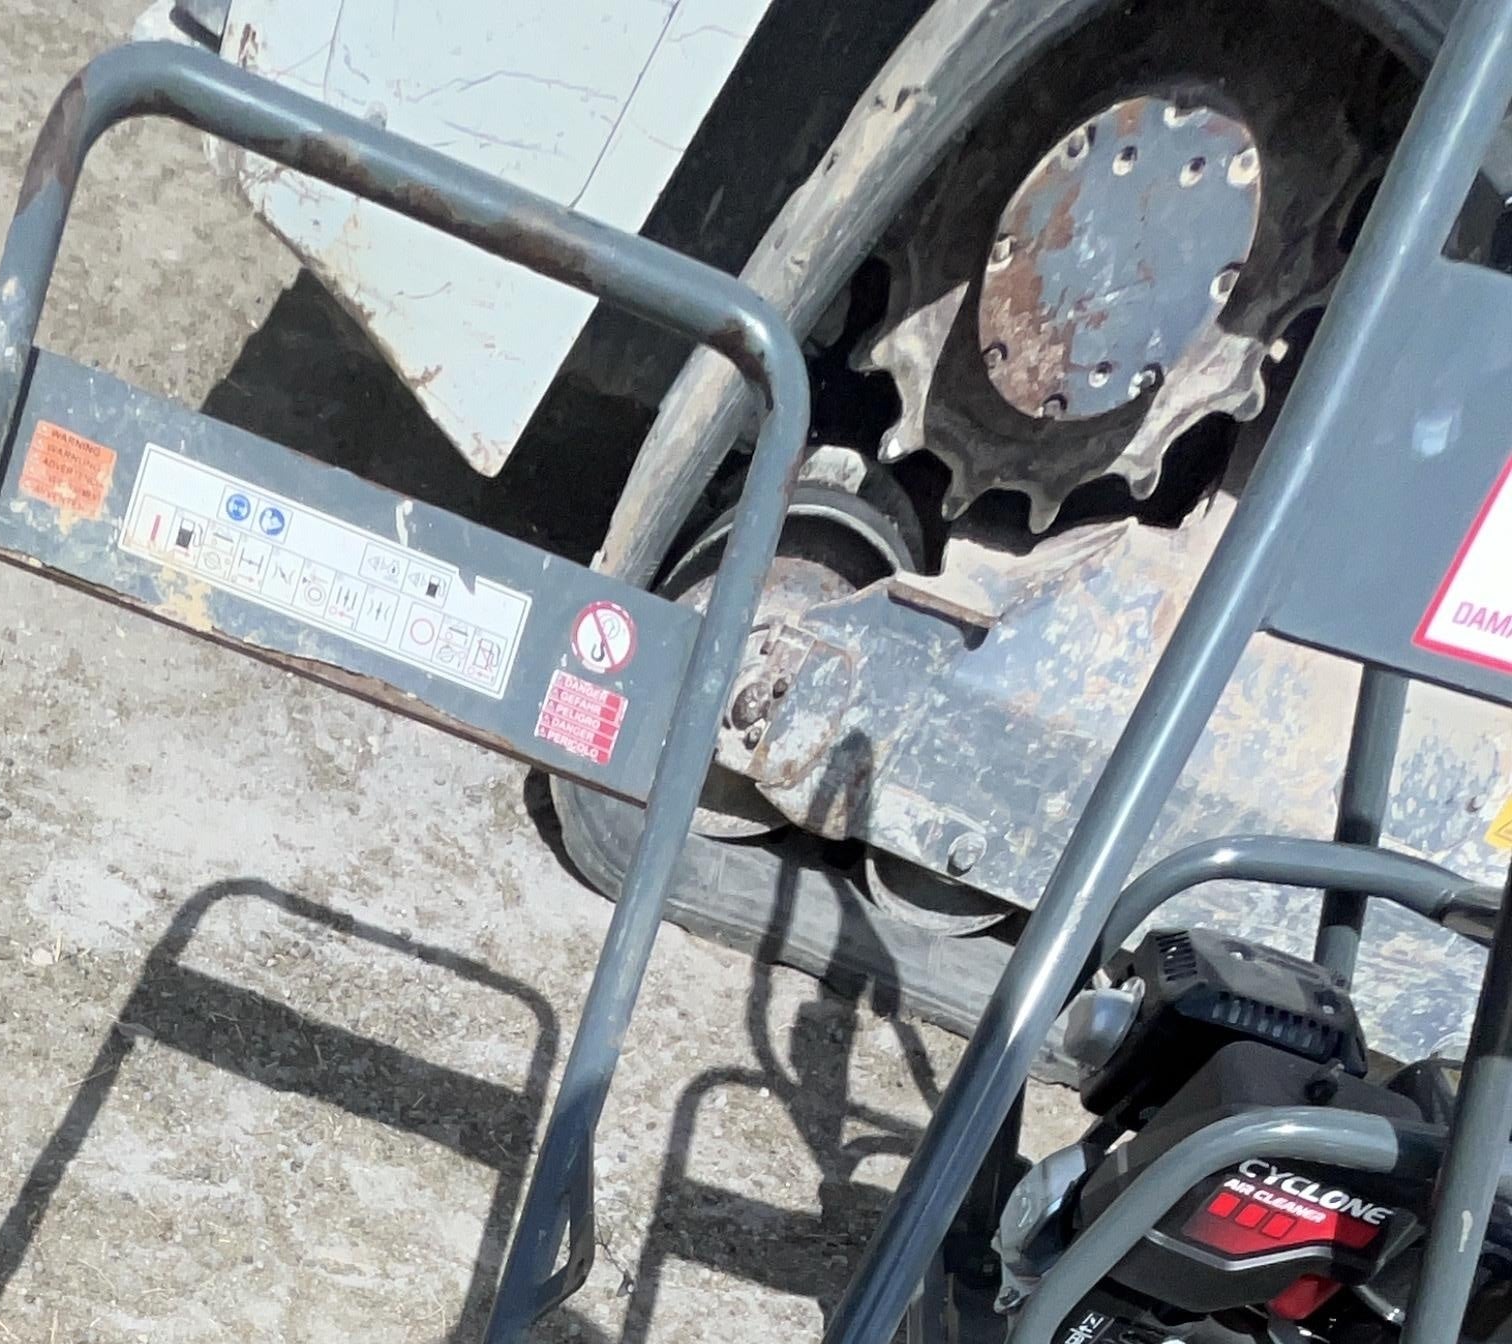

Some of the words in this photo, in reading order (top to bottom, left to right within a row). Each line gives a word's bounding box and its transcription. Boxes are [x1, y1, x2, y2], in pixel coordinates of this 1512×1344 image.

[1451, 601, 1512, 639] DAM
[560, 691, 602, 716] GEFAHR
[564, 677, 608, 703] DANGER
[551, 717, 595, 743] DANGER
[555, 703, 601, 730] PELIGRO
[546, 730, 600, 757] PERICOLO
[1223, 1177, 1256, 1196] AIR
[1252, 1190, 1328, 1224] CLEANER
[1238, 1158, 1394, 1226] CYCLONE
